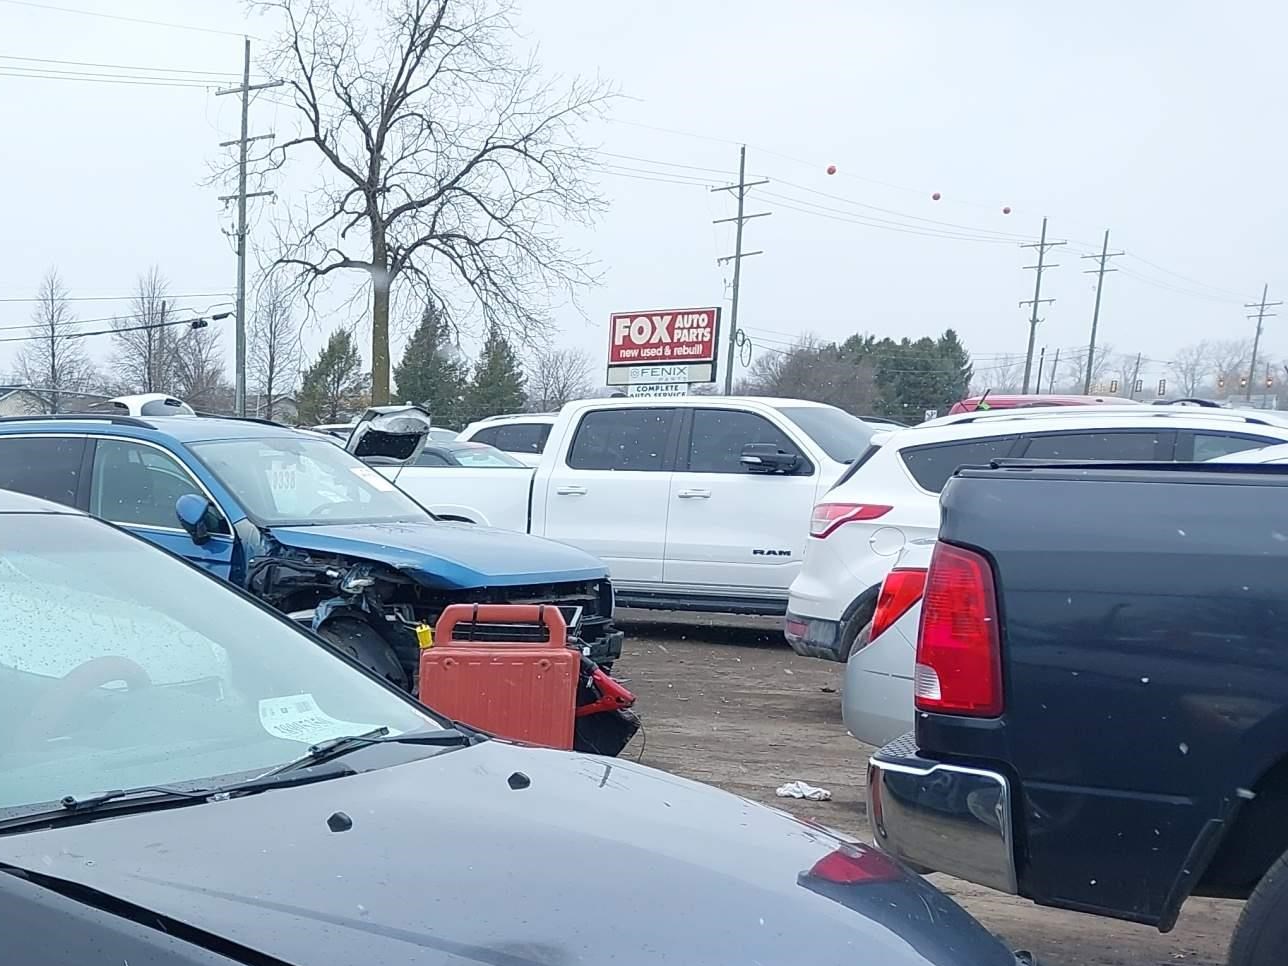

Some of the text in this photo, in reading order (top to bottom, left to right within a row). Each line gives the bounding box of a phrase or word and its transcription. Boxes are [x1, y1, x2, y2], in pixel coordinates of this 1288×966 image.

[674, 313, 708, 328] AUTO
[614, 315, 672, 345] FOX
[673, 328, 711, 343] PARTS
[619, 343, 703, 358] new used & rebuilt
[640, 366, 688, 377] FENIX
[752, 549, 792, 557] RAM
